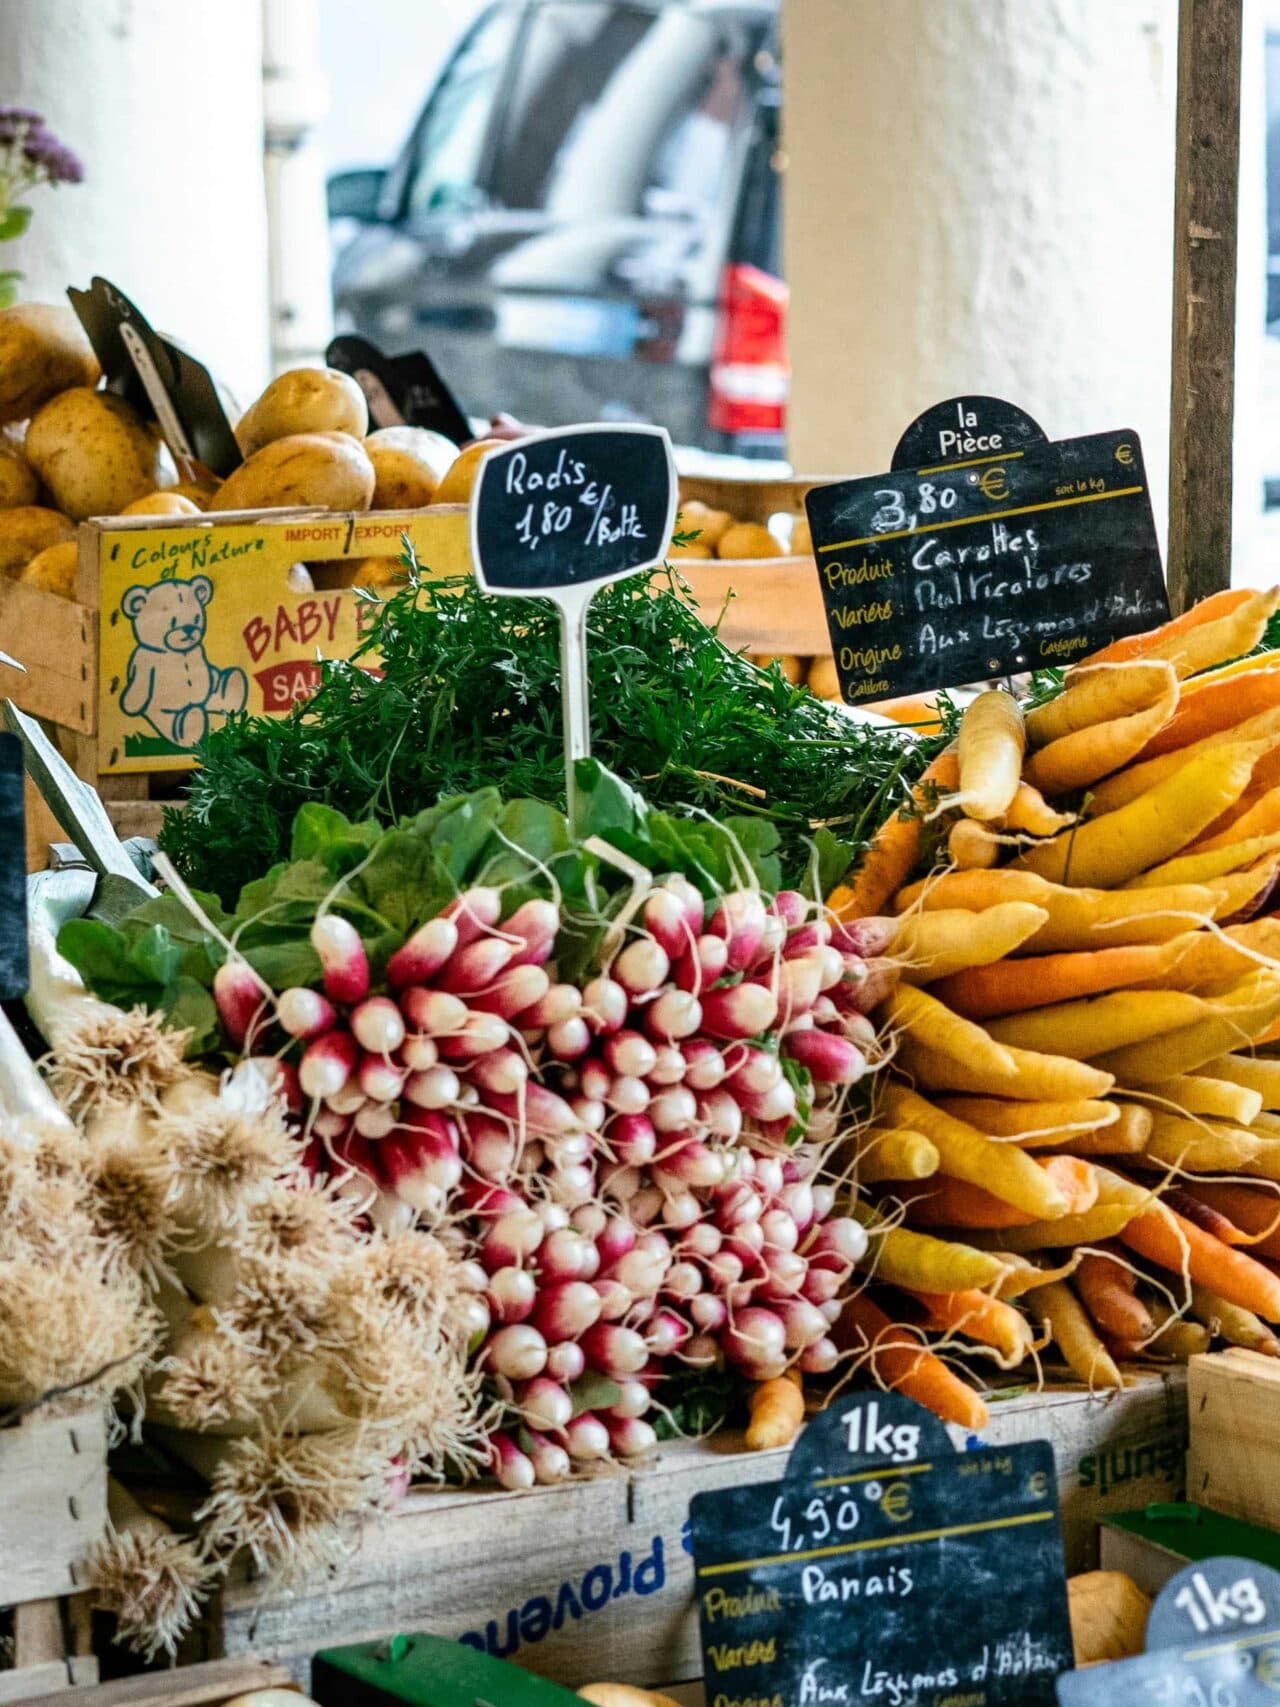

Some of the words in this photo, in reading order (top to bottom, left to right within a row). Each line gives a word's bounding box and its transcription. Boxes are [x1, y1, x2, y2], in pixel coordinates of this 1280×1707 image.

[958, 403, 978, 429] la
[939, 429, 1003, 456] Pièce
[1114, 444, 1133, 464] €
[506, 449, 586, 494] Radis
[871, 483, 957, 534] 3,80
[978, 467, 1010, 500] €
[285, 527, 340, 542] IMPORT
[354, 524, 412, 539] EXPORT
[515, 502, 572, 550] 1,80
[131, 534, 213, 569] Colours
[160, 559, 179, 579] of
[191, 538, 265, 570] Nature
[824, 558, 895, 590] Produit
[912, 522, 1039, 570] Carottes
[243, 597, 341, 663] BABY
[832, 600, 893, 629] Variété
[840, 644, 902, 675] Origine
[919, 623, 970, 654] Aux
[848, 678, 890, 698] Calibre
[841, 1401, 921, 1462] 1kg
[880, 1481, 914, 1523] €
[1027, 1471, 1049, 1500] €
[704, 1586, 782, 1623] Produit
[801, 1565, 914, 1605] Panais
[1175, 1572, 1266, 1632] 1kg
